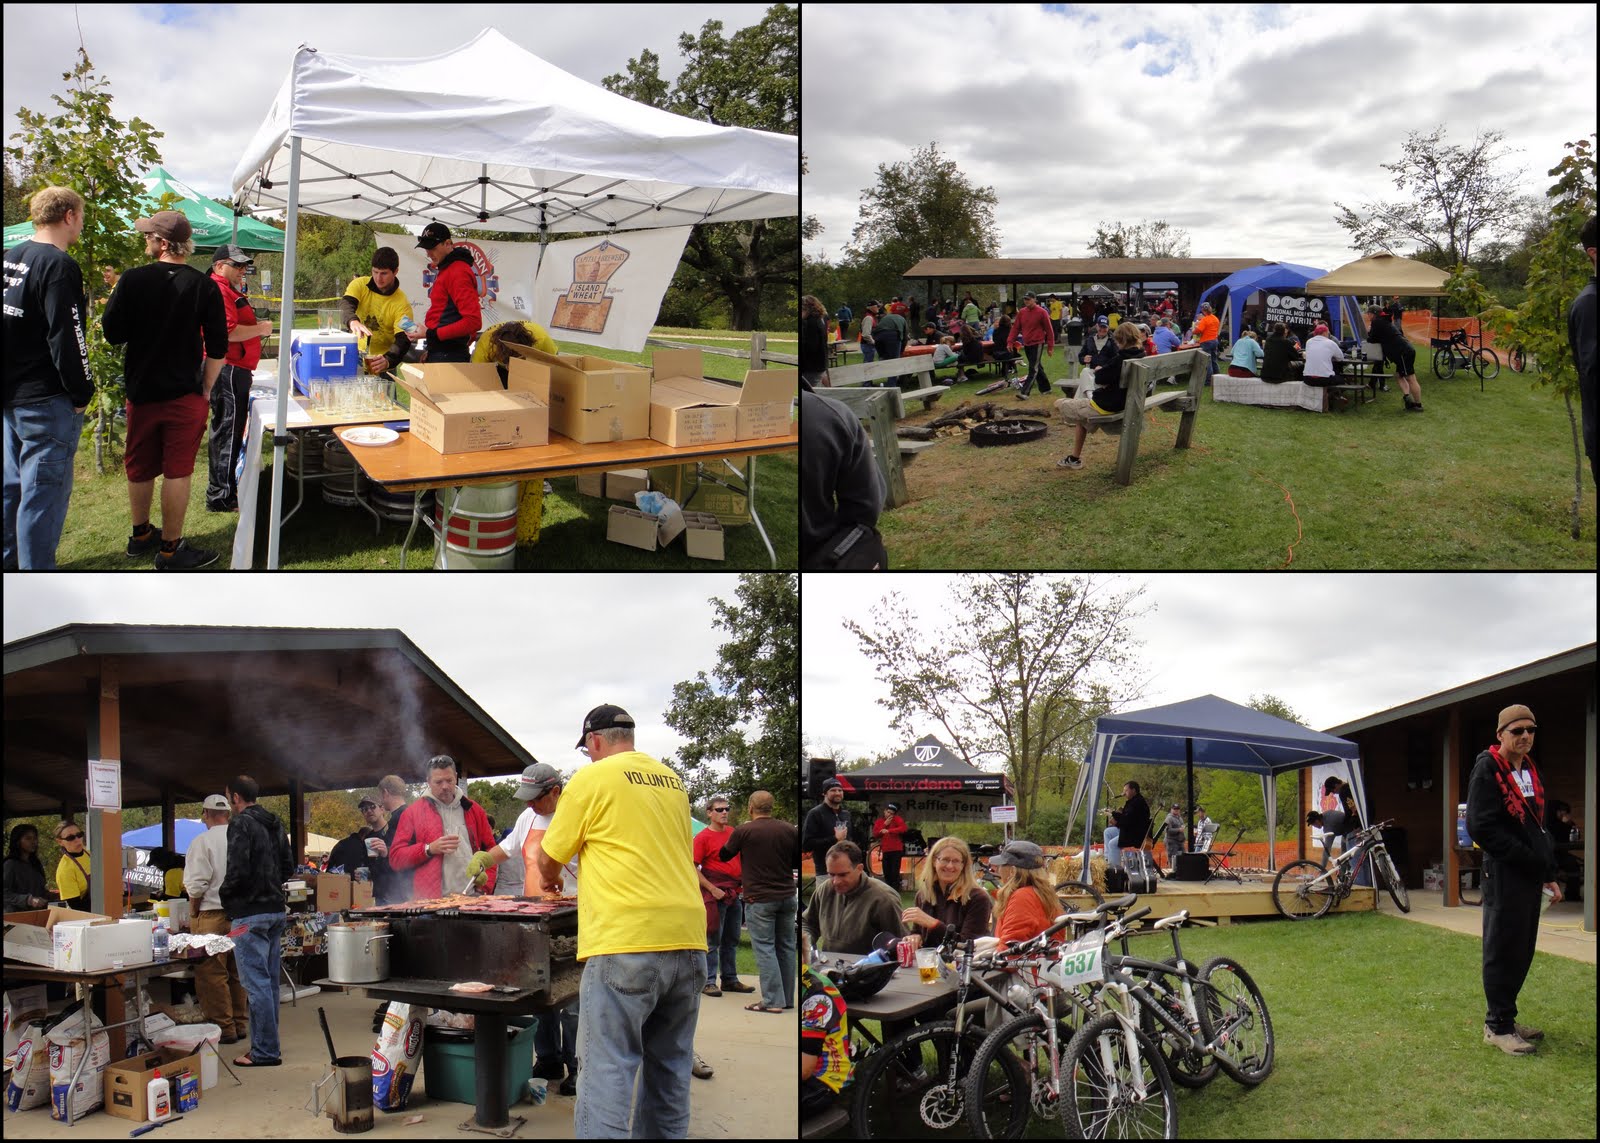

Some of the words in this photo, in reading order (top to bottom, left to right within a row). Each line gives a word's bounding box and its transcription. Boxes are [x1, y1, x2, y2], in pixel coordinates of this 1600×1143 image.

[574, 284, 601, 292] ISLAND
[573, 291, 598, 300] WHEAT
[1266, 314, 1284, 322] BIKE
[905, 799, 949, 812] Raffle
[952, 800, 984, 813] Tent
[1064, 951, 1097, 976] 537
